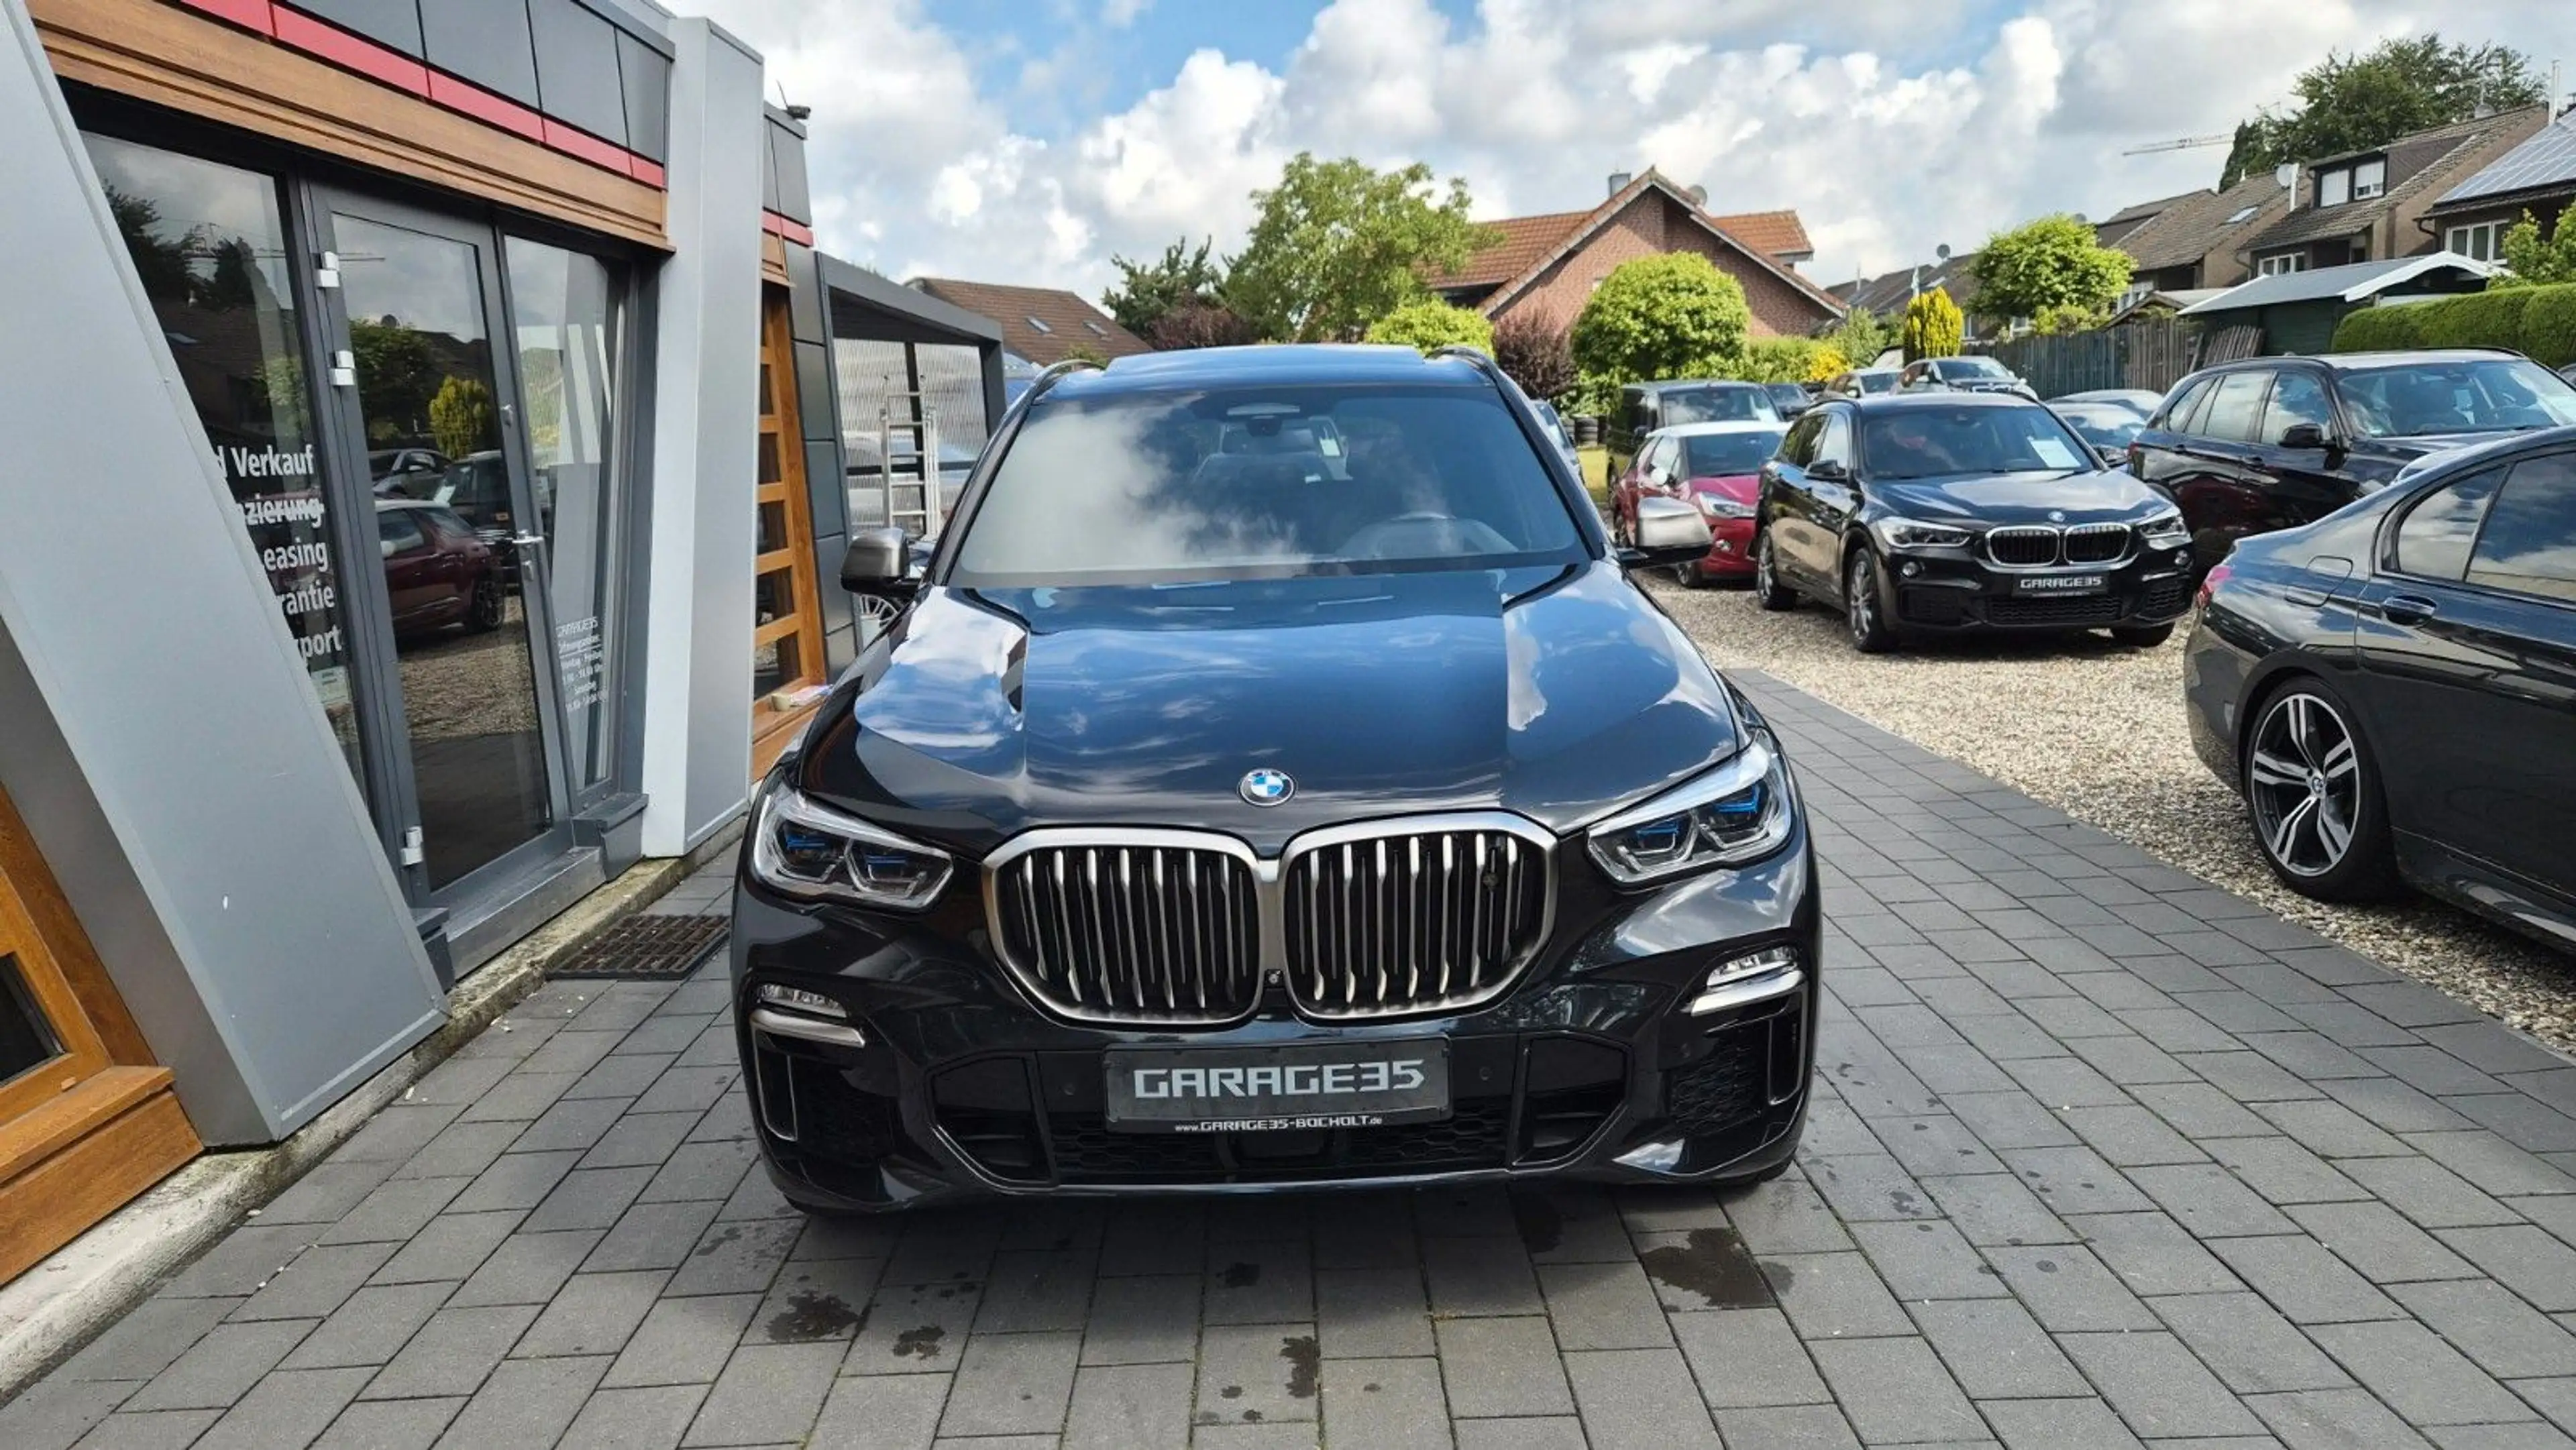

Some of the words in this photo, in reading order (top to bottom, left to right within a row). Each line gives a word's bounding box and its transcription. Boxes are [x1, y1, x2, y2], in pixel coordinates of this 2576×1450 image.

[230, 444, 314, 477] Verkauf
[240, 493, 325, 528] zierung
[264, 537, 328, 572] easing
[282, 579, 335, 616] antie
[2020, 576, 2102, 588] GARAGE35
[301, 624, 342, 660] port
[1134, 1059, 1425, 1099] GARAGE35
[1175, 1115, 1383, 1132] www.GARAGE35-BOCHOLT.de
